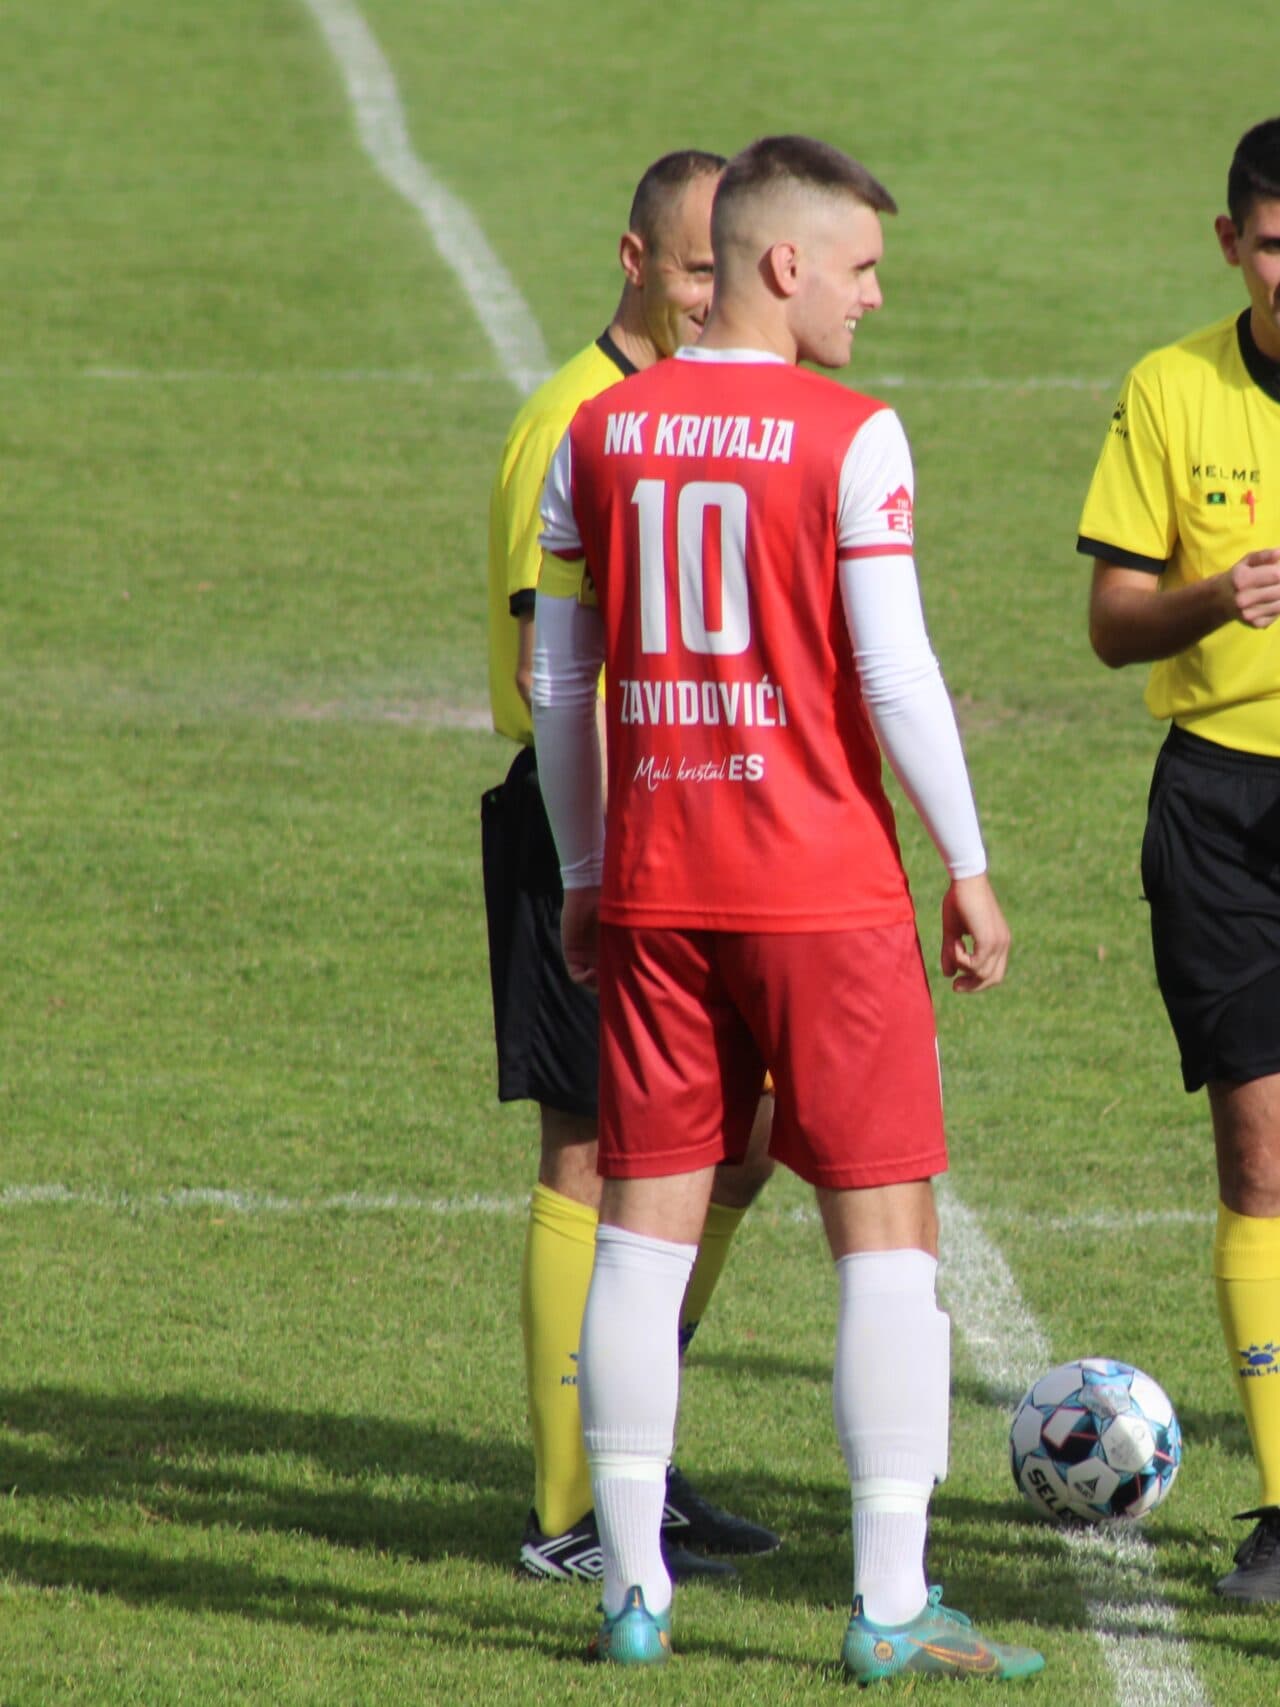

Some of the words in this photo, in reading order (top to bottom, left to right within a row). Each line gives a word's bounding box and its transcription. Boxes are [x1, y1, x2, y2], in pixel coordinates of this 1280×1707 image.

[604, 411, 649, 455] NK
[654, 413, 795, 464] KRIVAJA
[1191, 464, 1260, 483] KELME
[630, 479, 751, 656] 10
[633, 755, 671, 792] Mali
[728, 754, 765, 781] ES
